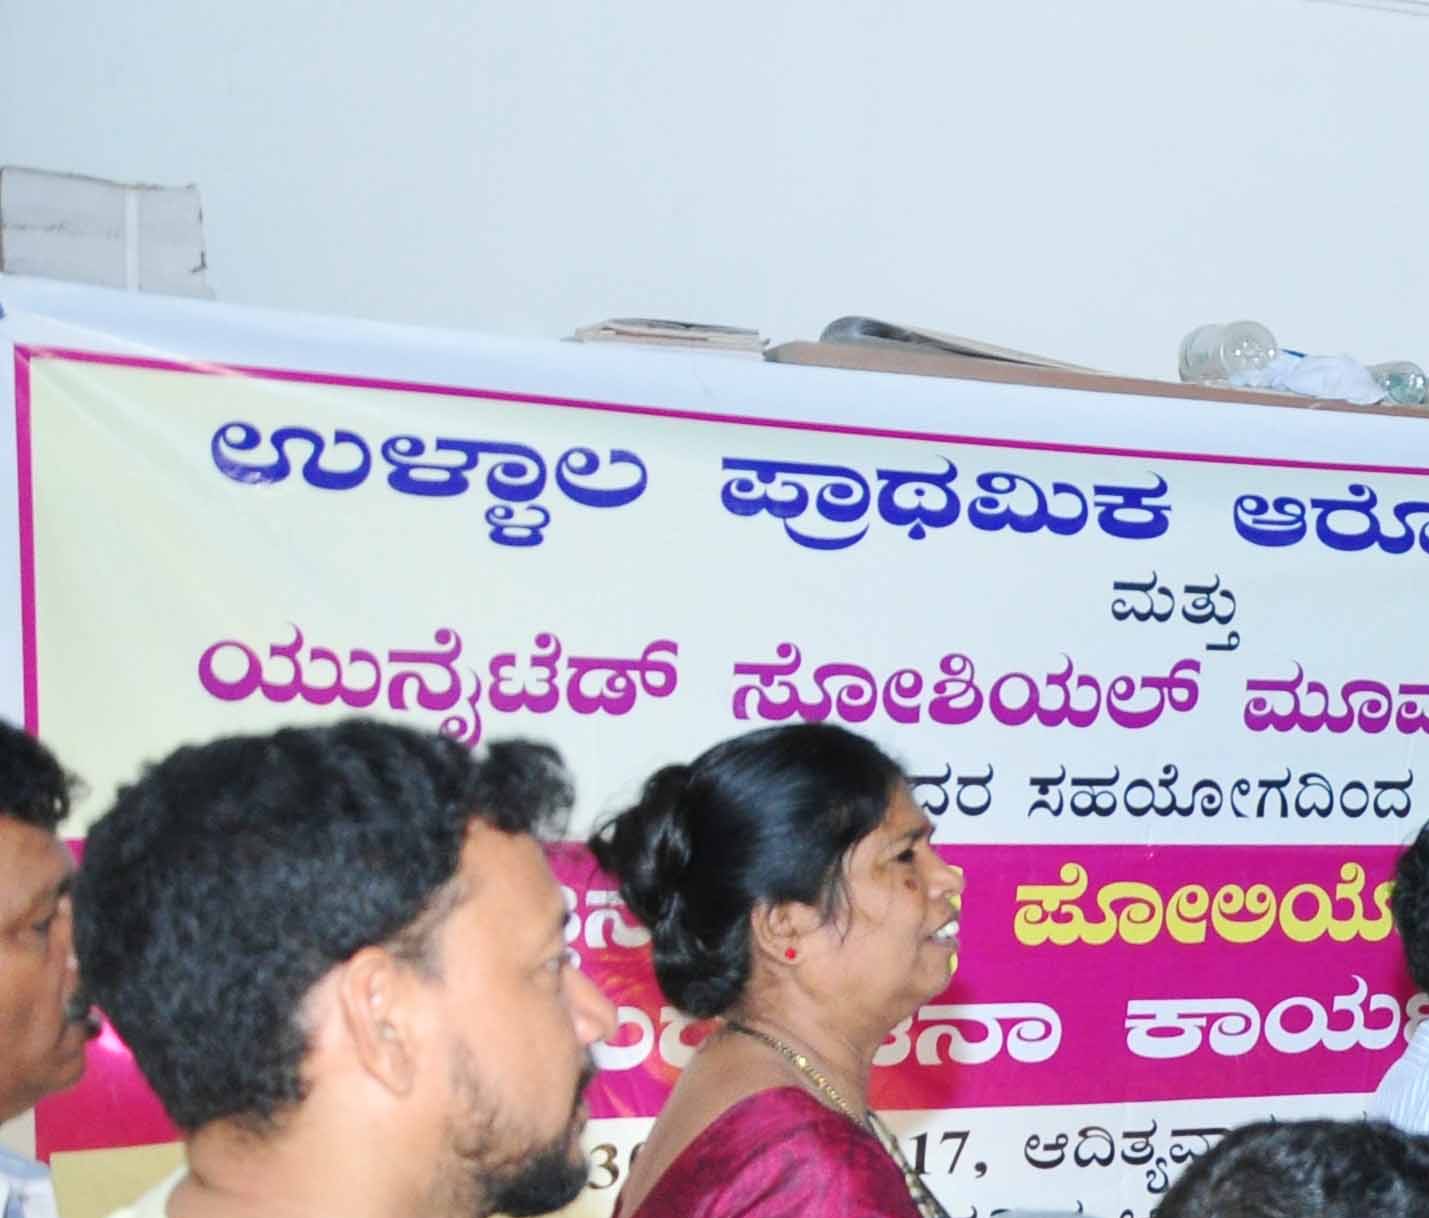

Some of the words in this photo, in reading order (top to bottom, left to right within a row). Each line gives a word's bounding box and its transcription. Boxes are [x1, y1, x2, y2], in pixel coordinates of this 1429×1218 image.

[211, 421, 649, 547] ಉಳ್ಳಾಲ
[721, 455, 1172, 551] ಪ್ರಾಥಮಿಕ
[1111, 570, 1241, 652] ಮತ್ತು
[199, 622, 679, 748] ಯುನೈಟೆಡ್
[732, 642, 1201, 728] ಸೋಶಿಯಲ್
[1028, 757, 1415, 820] ಸಹಯೋಗದಿಂದ
